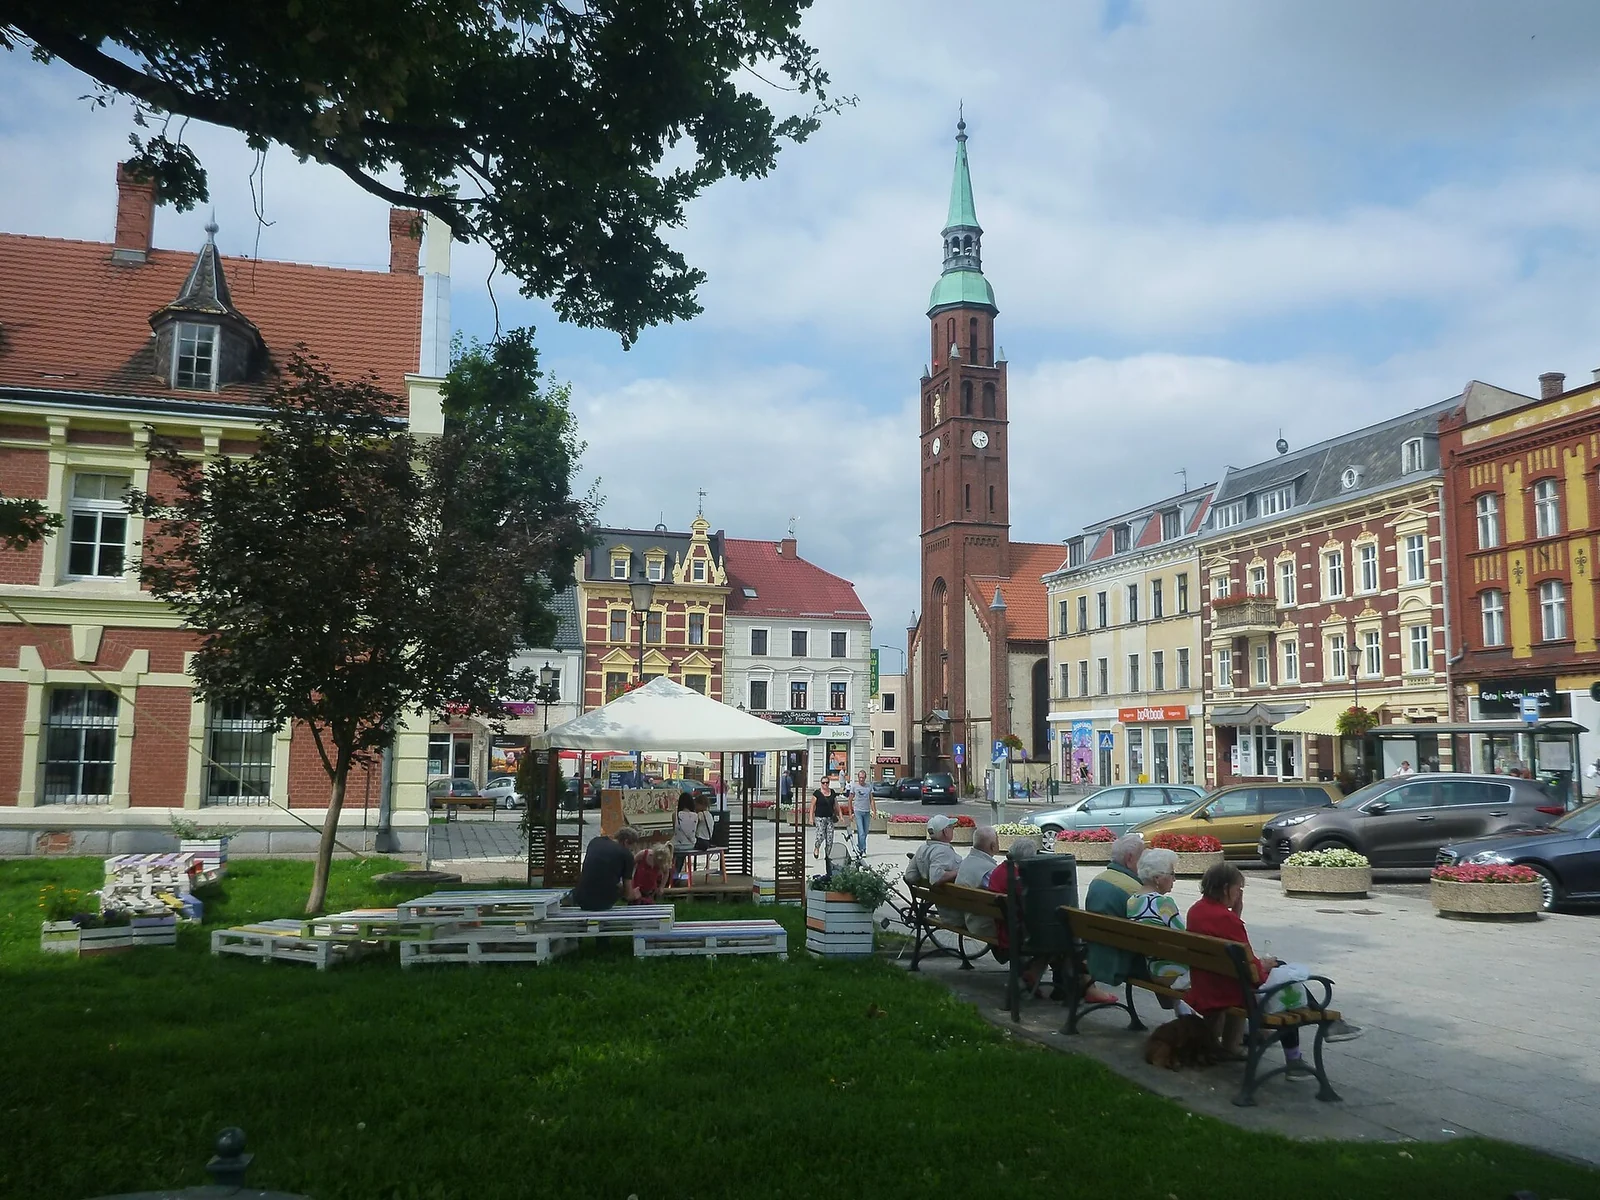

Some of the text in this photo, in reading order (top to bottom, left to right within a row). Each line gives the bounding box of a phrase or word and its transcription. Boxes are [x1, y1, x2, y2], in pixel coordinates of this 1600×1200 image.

[1482, 692, 1498, 700] foto
[1501, 690, 1522, 699] video
[996, 742, 1002, 750] P
